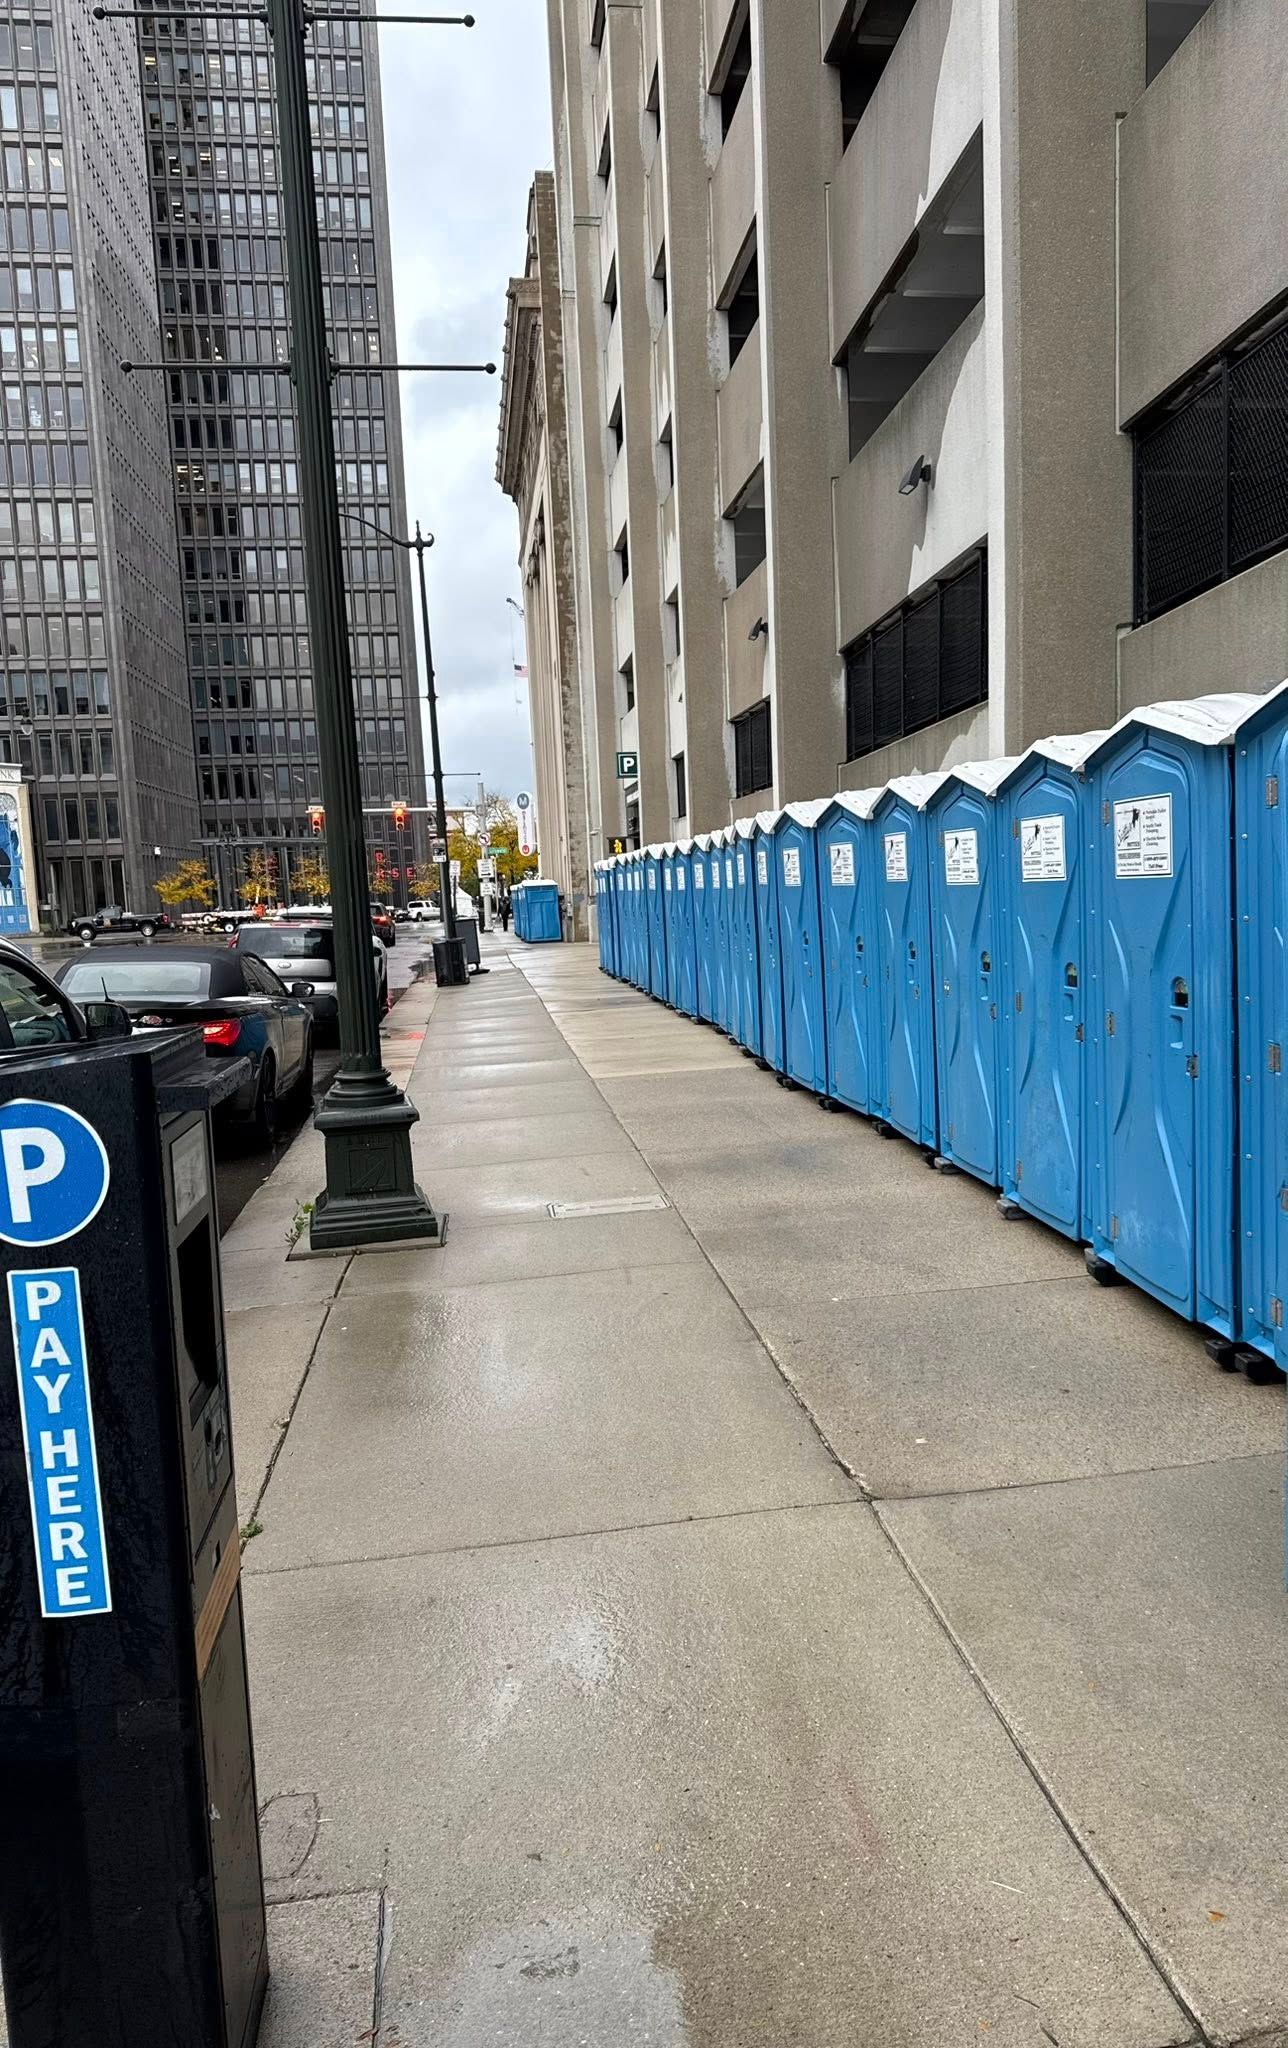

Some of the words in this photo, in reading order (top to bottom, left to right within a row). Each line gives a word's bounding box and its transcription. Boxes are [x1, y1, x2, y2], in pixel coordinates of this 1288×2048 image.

[623, 757, 635, 772] P
[1, 1127, 66, 1224] P
[25, 1280, 72, 1414] PAY
[40, 1428, 91, 1606] HERE
